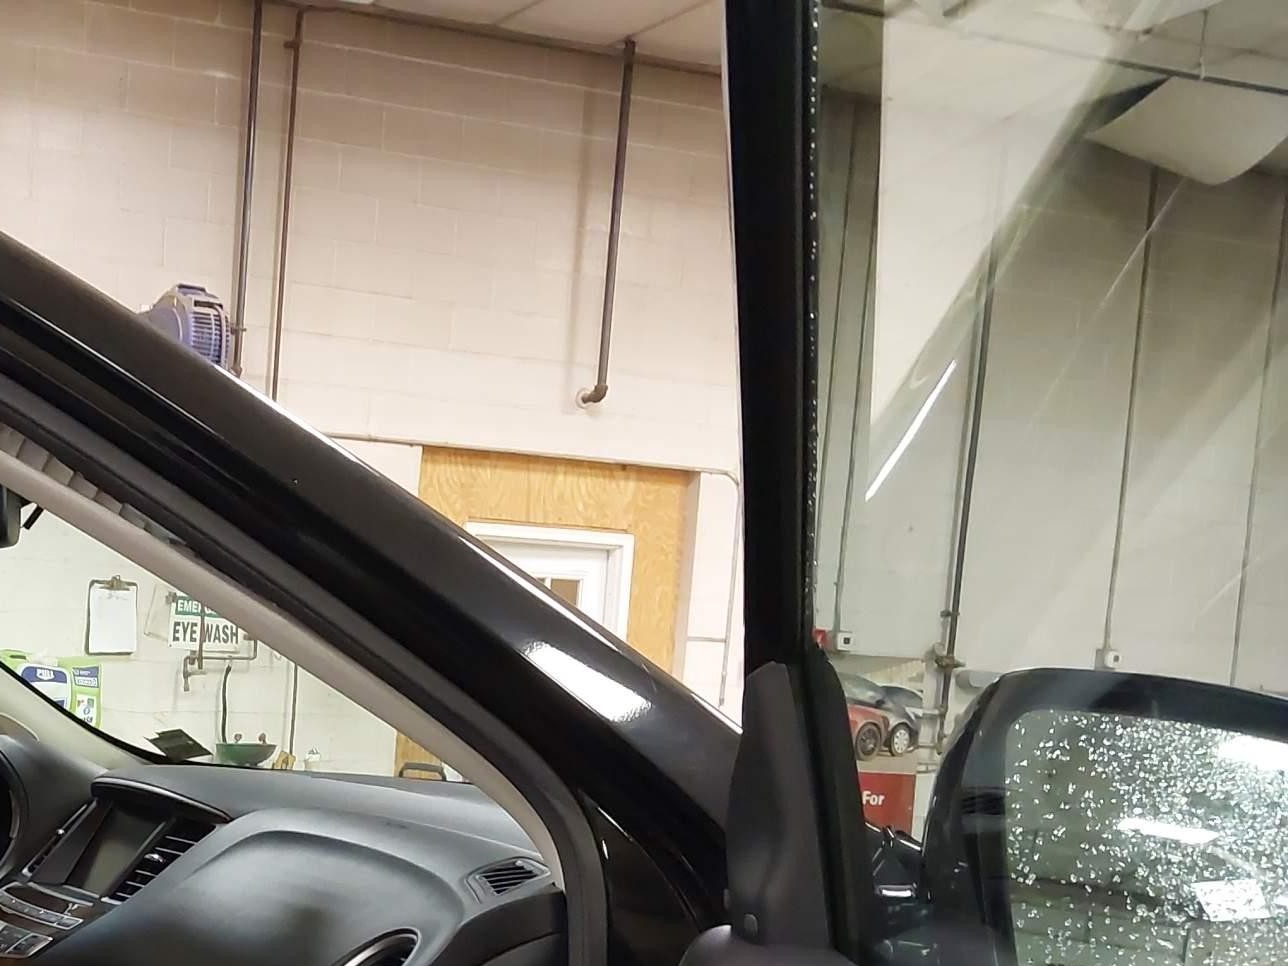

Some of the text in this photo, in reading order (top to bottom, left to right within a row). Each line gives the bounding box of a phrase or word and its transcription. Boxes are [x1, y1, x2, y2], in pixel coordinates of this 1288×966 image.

[172, 621, 239, 645] EYE WASH
[862, 790, 885, 806] For
